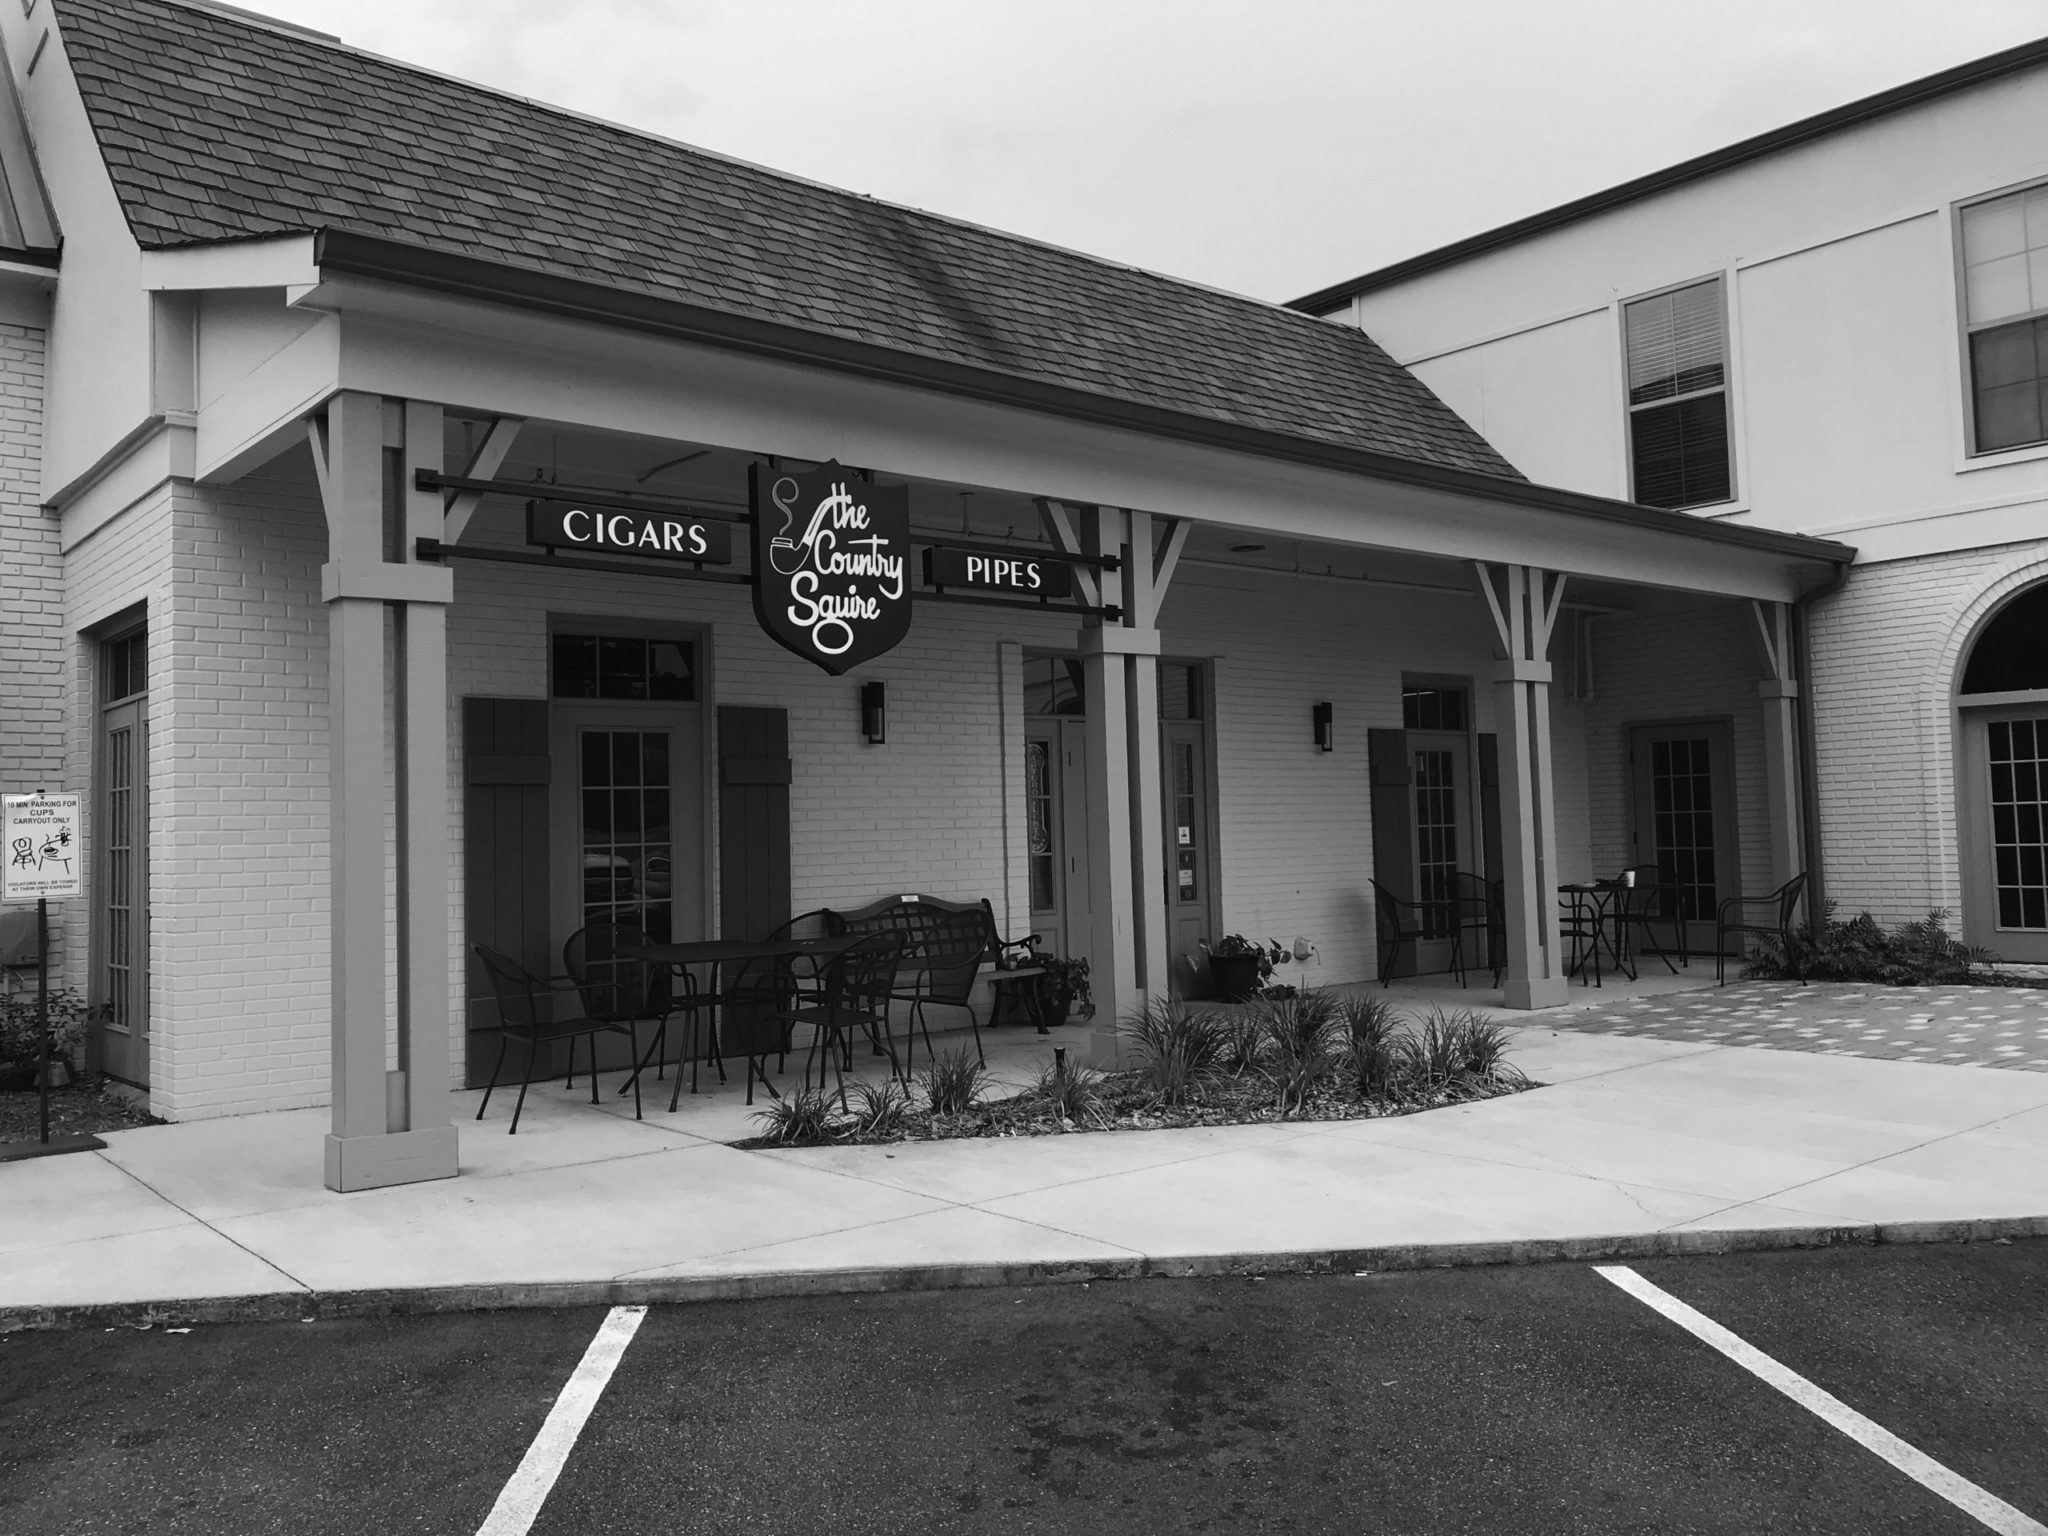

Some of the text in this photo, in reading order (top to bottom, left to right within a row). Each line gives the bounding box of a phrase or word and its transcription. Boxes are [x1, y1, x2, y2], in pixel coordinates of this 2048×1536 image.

[831, 482, 870, 529] the
[563, 510, 707, 554] CIGARS
[814, 529, 903, 600] Country
[967, 556, 1041, 588] PIPES
[788, 570, 880, 654] Squire
[52, 816, 71, 824] ONLY
